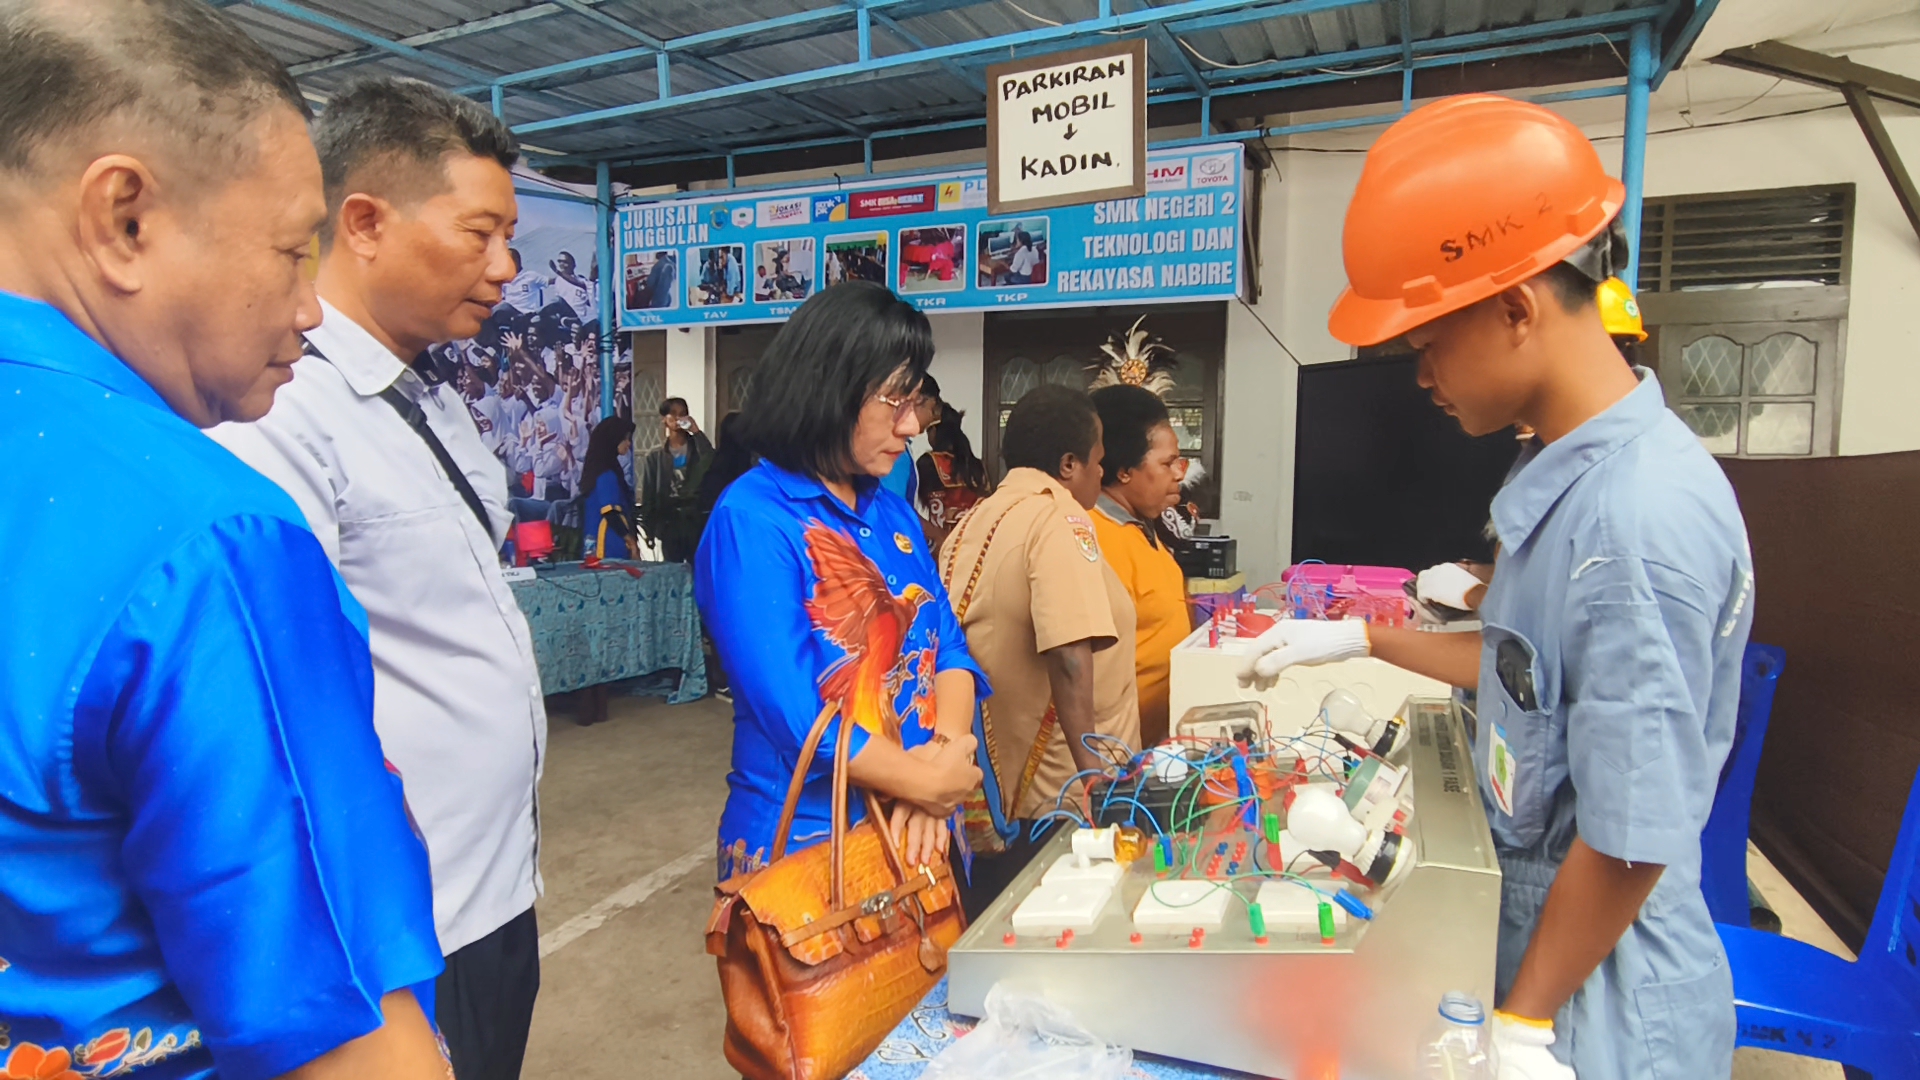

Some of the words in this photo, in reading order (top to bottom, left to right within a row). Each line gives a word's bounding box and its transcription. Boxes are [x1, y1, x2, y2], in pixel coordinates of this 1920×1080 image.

[1003, 60, 1125, 101] PARKIRAN
[1032, 92, 1115, 124] MOBIL
[1197, 176, 1228, 184] TOYOTA
[624, 205, 698, 230] JURUSAN
[1093, 198, 1140, 224] SMK
[1145, 193, 1215, 221] NEGERI
[1221, 192, 1235, 215] 2
[624, 223, 709, 249] UNGGULAN
[1440, 214, 1524, 263] SMK
[1535, 192, 1552, 215] 2
[1082, 229, 1186, 259] TEKNOLOGI
[1192, 226, 1234, 251] DAN
[1057, 266, 1154, 293] REKAYASA
[1161, 261, 1233, 288] NABIRE
[916, 298, 947, 307] TKR
[995, 293, 1028, 302] TKP
[703, 311, 728, 319] TAV
